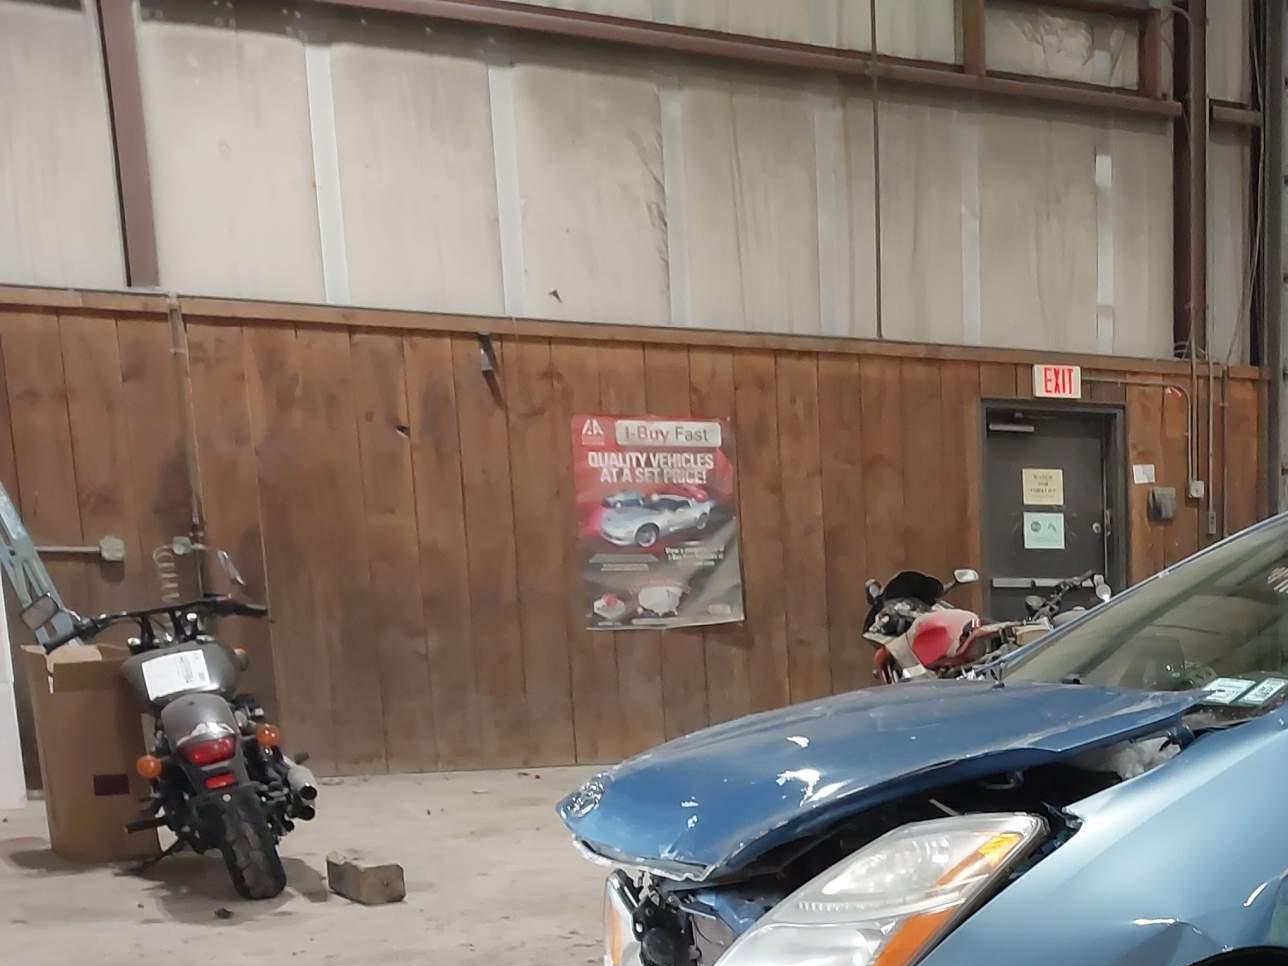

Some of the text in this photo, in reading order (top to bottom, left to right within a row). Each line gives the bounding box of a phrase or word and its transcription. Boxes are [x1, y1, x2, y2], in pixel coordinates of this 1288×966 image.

[1043, 367, 1074, 395] EXIT
[675, 426, 709, 442] Fast
[588, 451, 714, 469] QUALITY VEHICLES
[600, 468, 707, 485] AT A SET PRICE!
